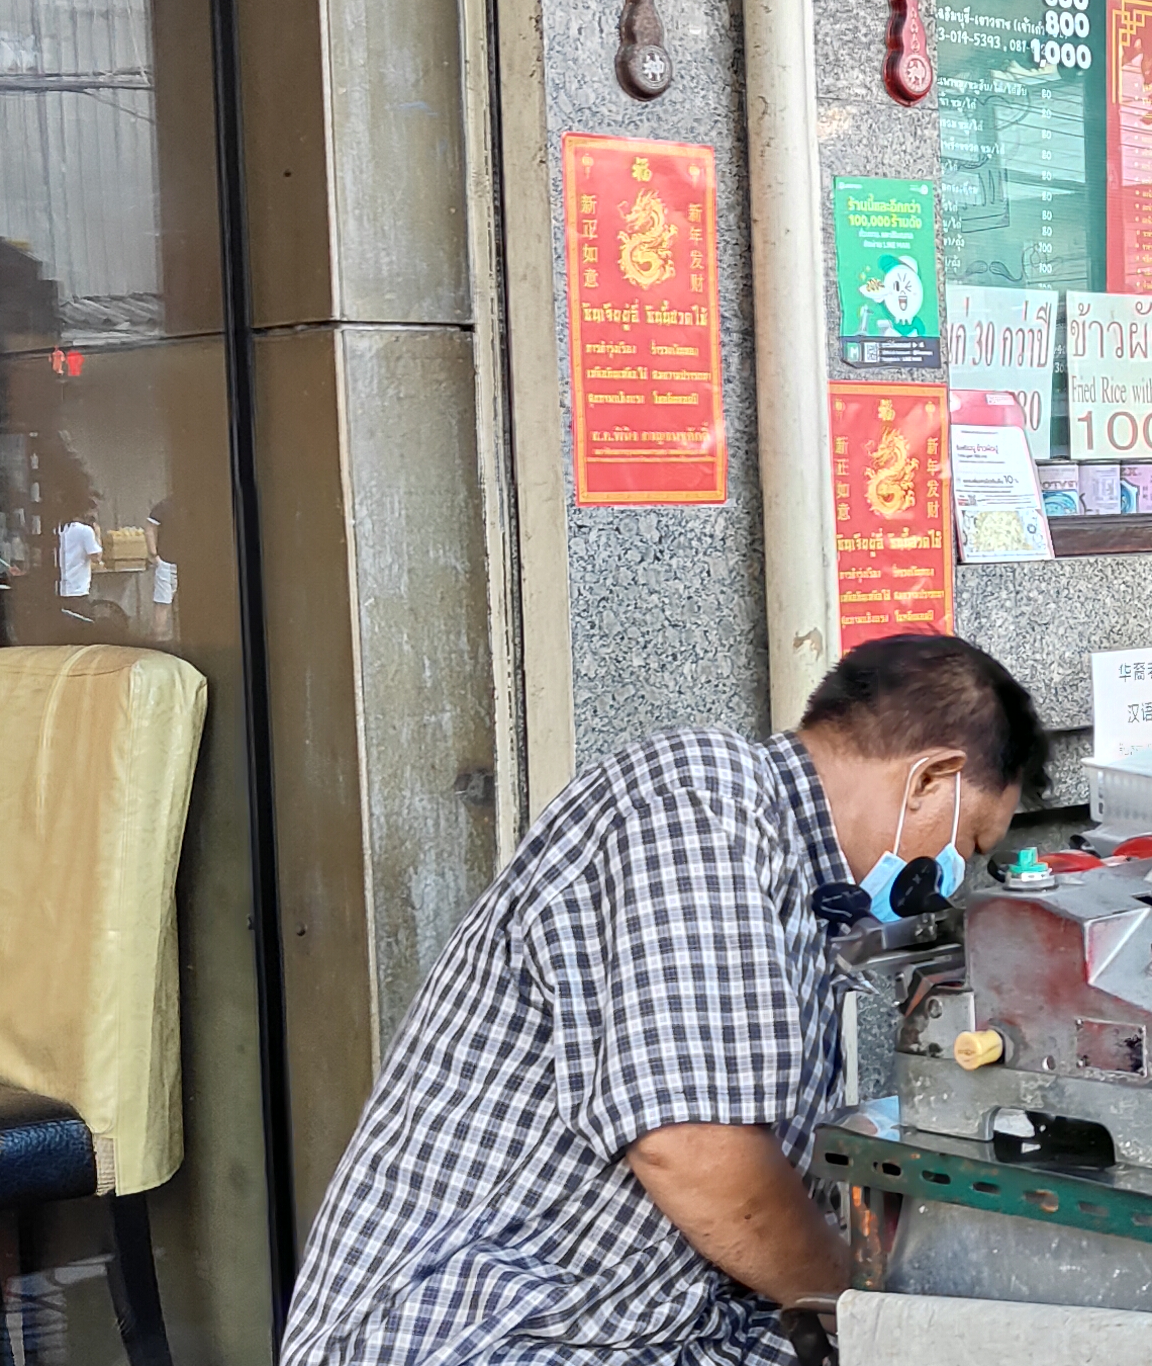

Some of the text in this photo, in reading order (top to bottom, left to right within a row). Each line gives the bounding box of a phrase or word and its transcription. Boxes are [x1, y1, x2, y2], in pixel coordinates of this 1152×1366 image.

[938, 27, 1001, 49] 3-014-5393
[1044, 10, 1091, 39] 800
[1030, 38, 1093, 69] 1,000
[972, 320, 996, 367] 30
[1001, 300, 1052, 369] กว่าปี
[1071, 375, 1097, 404] Fried
[1101, 376, 1127, 405] Rice
